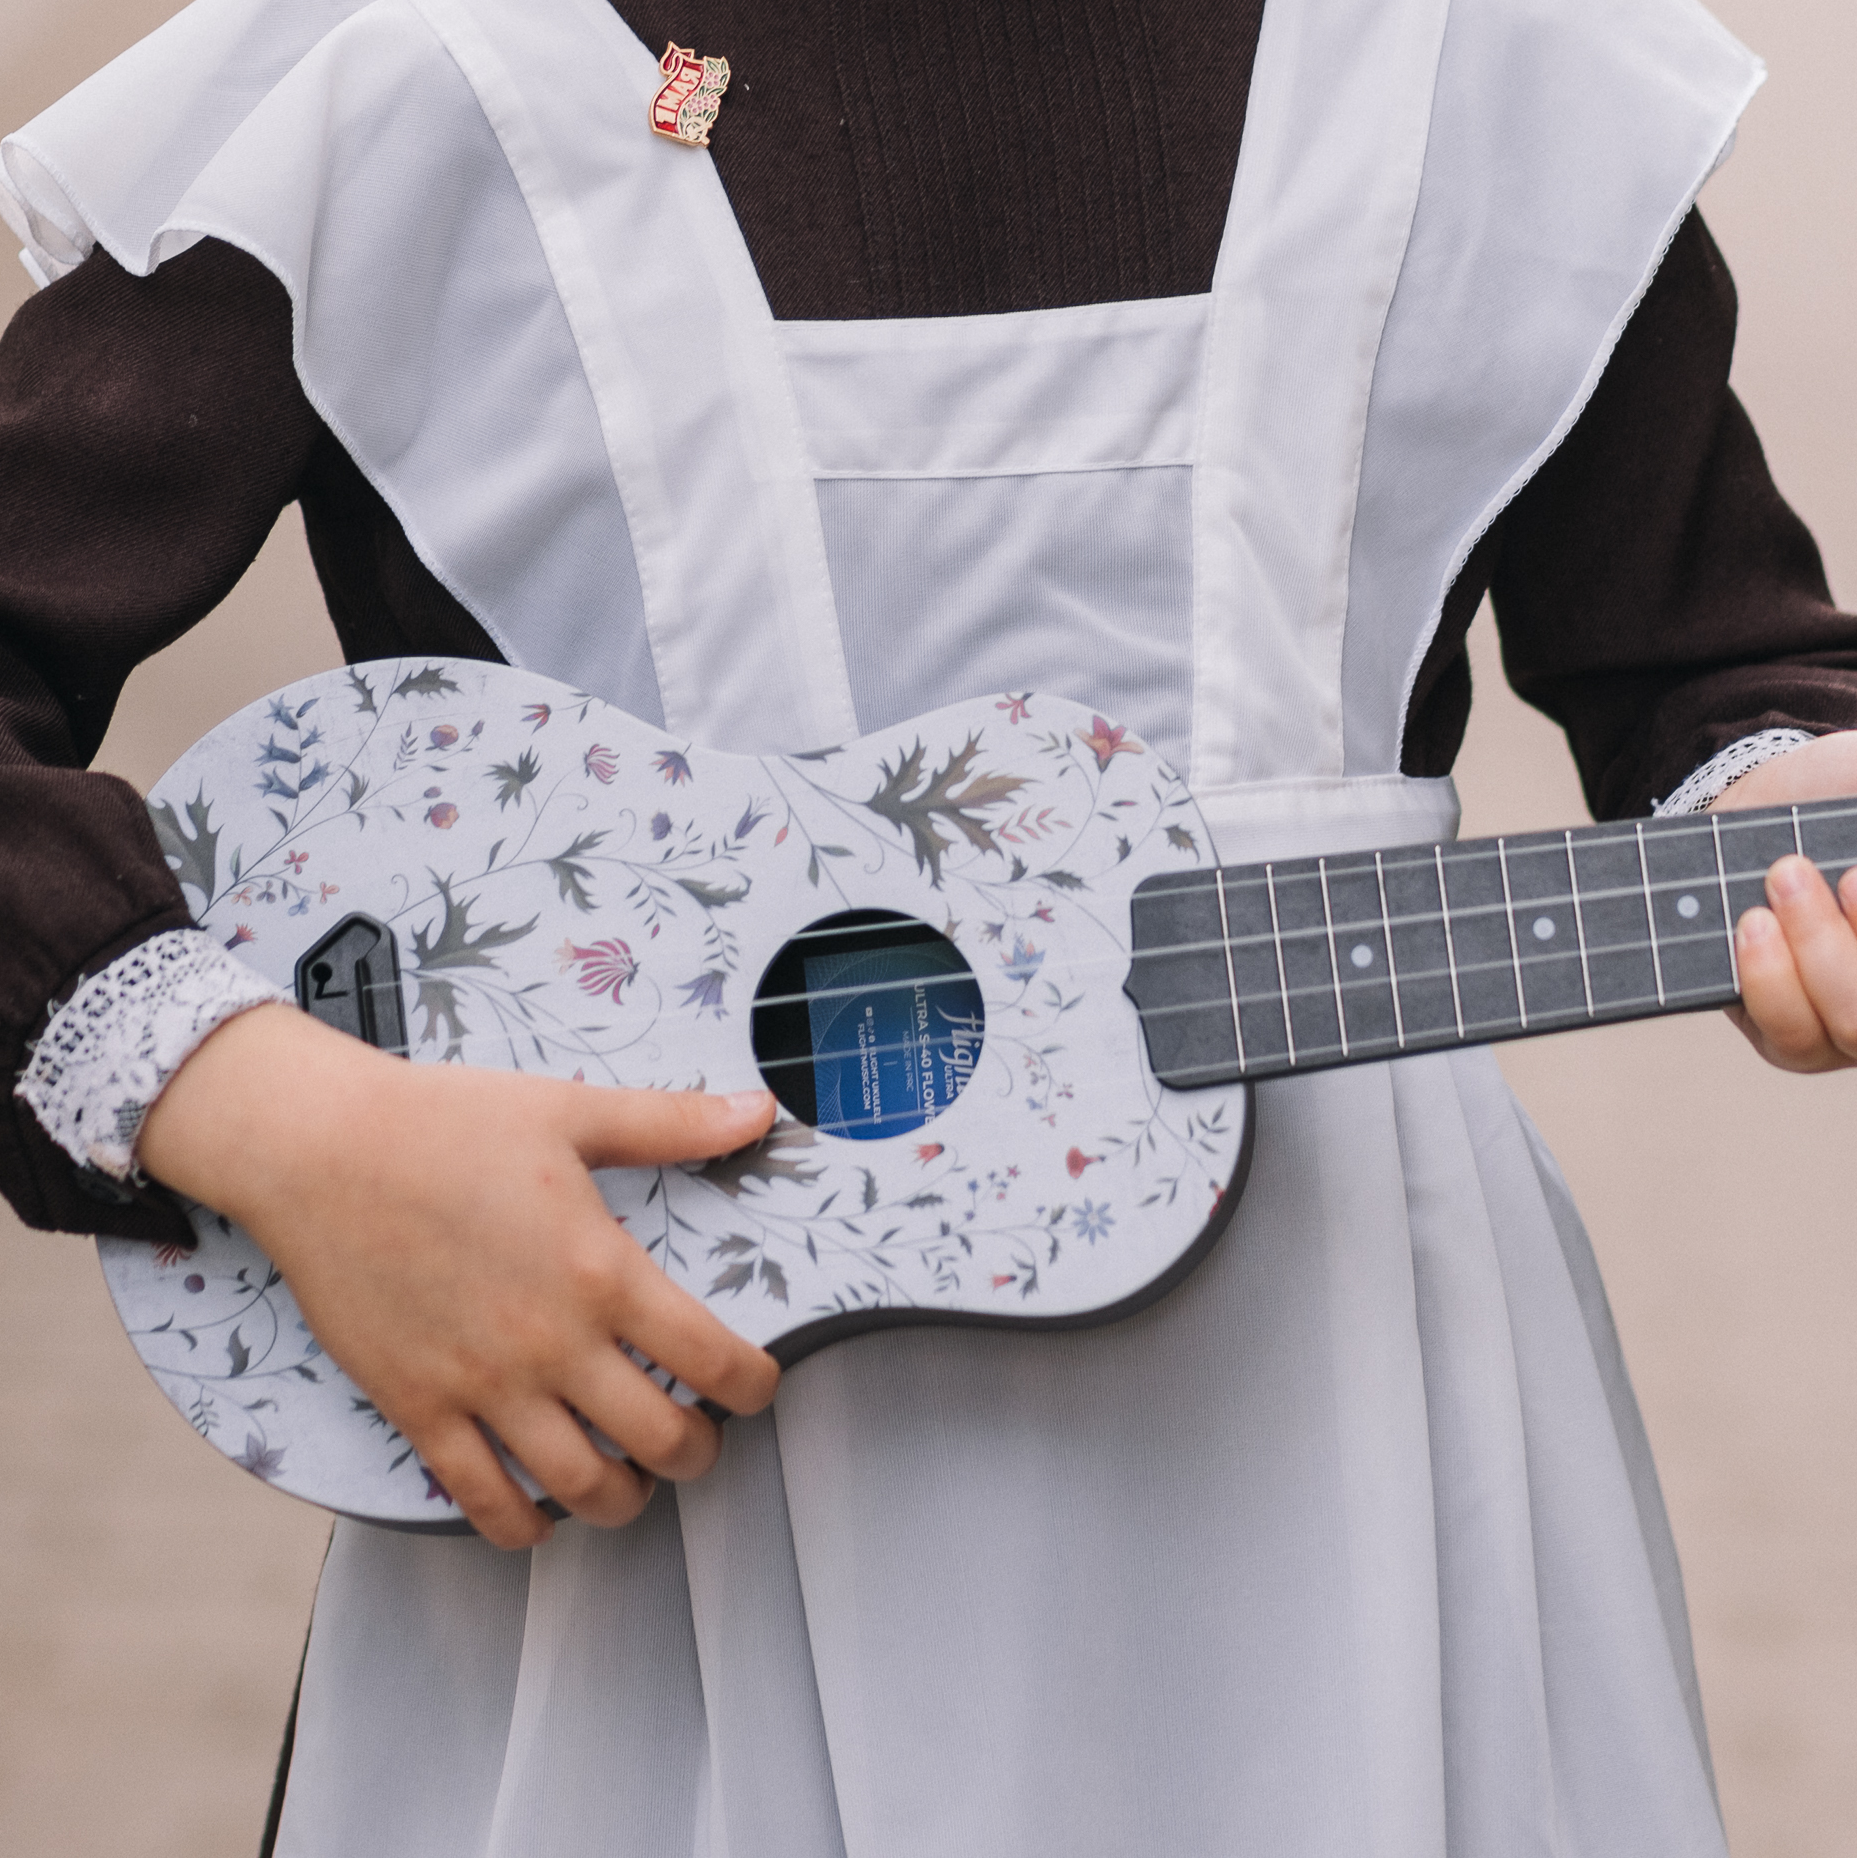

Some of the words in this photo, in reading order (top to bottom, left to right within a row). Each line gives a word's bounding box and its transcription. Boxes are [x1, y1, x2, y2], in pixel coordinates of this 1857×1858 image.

[656, 67, 701, 111] МАЯ
[656, 107, 676, 124] 1
[914, 985, 928, 1031] ULTRA
[903, 1031, 911, 1058] MADE
[920, 1034, 931, 1067] S-40
[906, 1061, 912, 1070] IN
[944, 1066, 953, 1099] ULTRA
[872, 1081, 881, 1125] UKULELE
